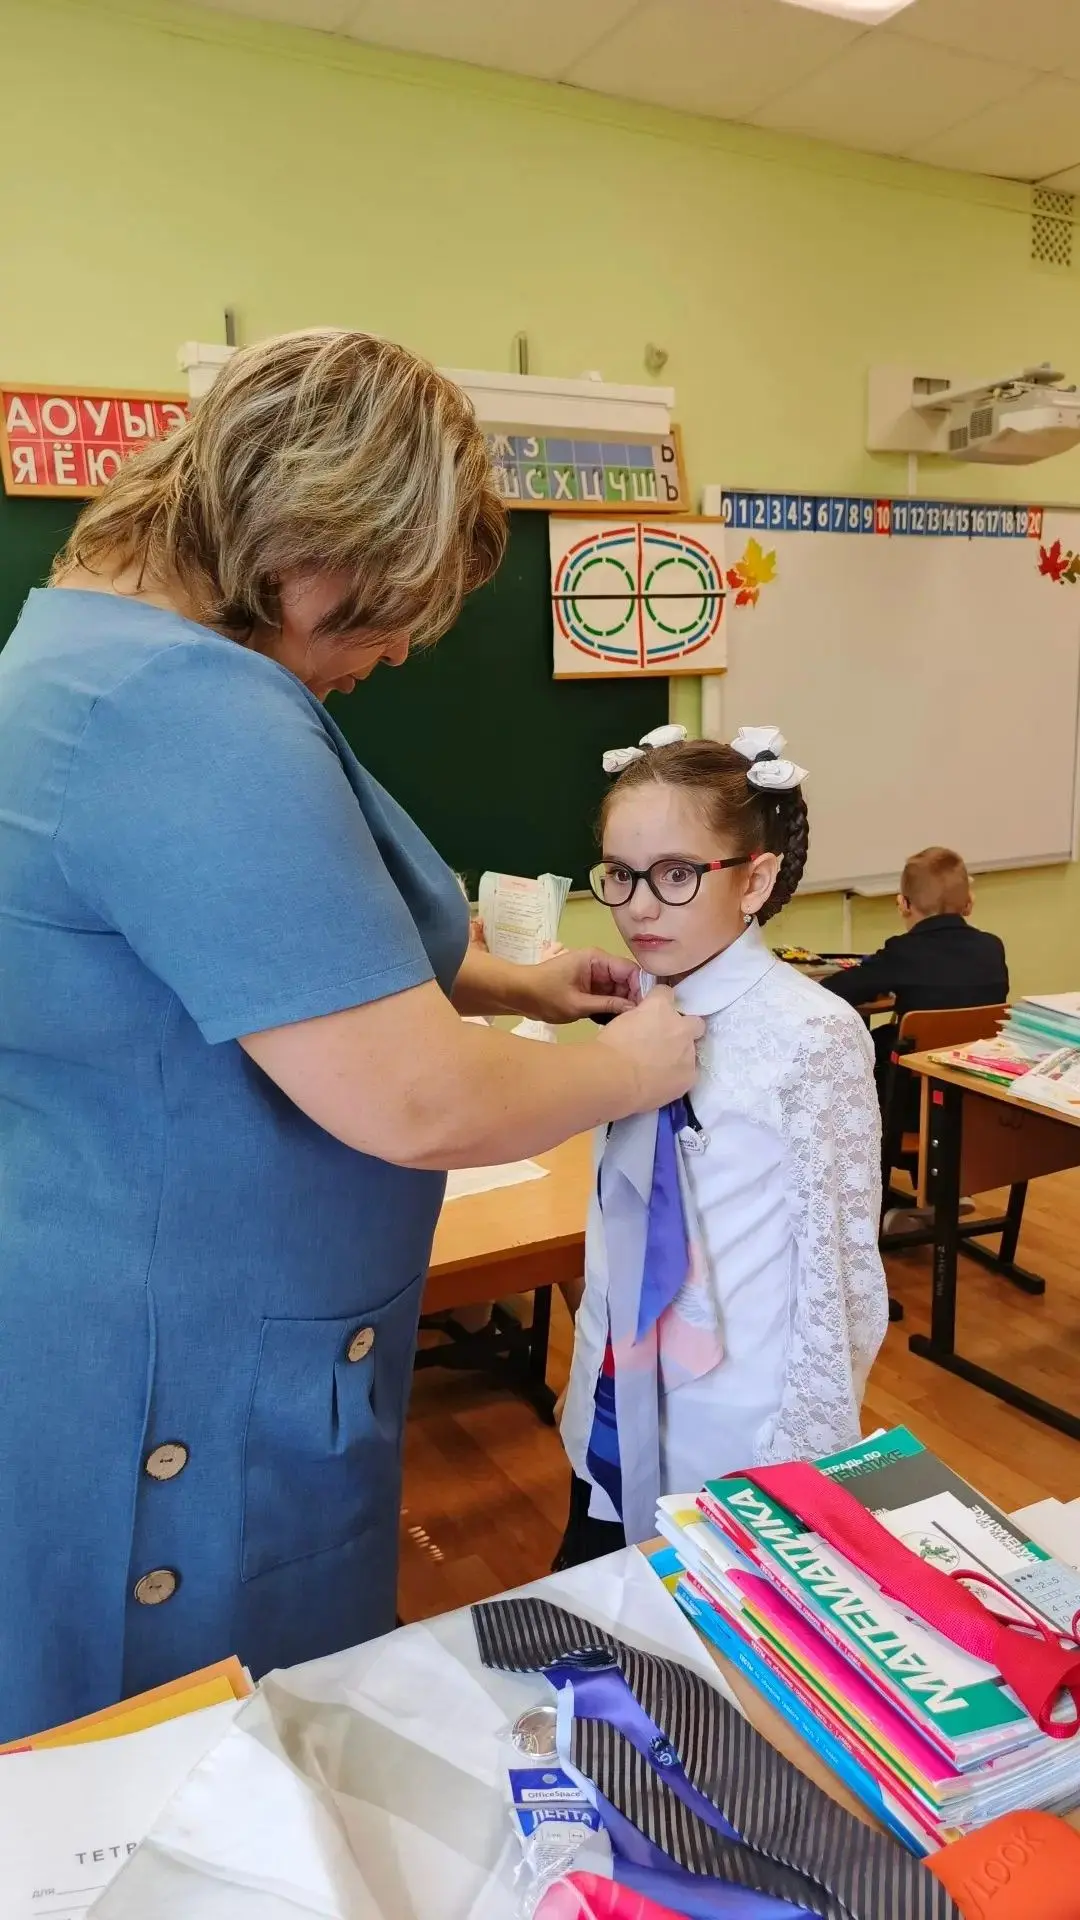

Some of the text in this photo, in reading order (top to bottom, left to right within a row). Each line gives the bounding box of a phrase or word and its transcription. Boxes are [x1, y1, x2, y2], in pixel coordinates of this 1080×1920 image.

[6, 396, 37, 434] А
[41, 398, 77, 436] О
[83, 400, 110, 436] У
[122, 402, 156, 438] Ы
[13, 443, 121, 486] Я Ё Ю
[525, 467, 545, 500] С
[553, 470, 573, 500] Х
[608, 471, 627, 501] Ч
[722, 498, 1041, 534] 0 1 2 3 4 5 6 7 8 9 10 11 12 13 14 15 16 17 18 19 20
[819, 1458, 863, 1477] ЕТРАДЬ
[831, 1449, 903, 1482] ТЕМАТИКЕ
[971, 1504, 1042, 1564] МАТЕМАТИКЕ
[727, 1488, 970, 1713] МАТЕМАТИКА
[533, 1809, 593, 1828] ЛЕНТА
[75, 1842, 137, 1864] ТЕТР
